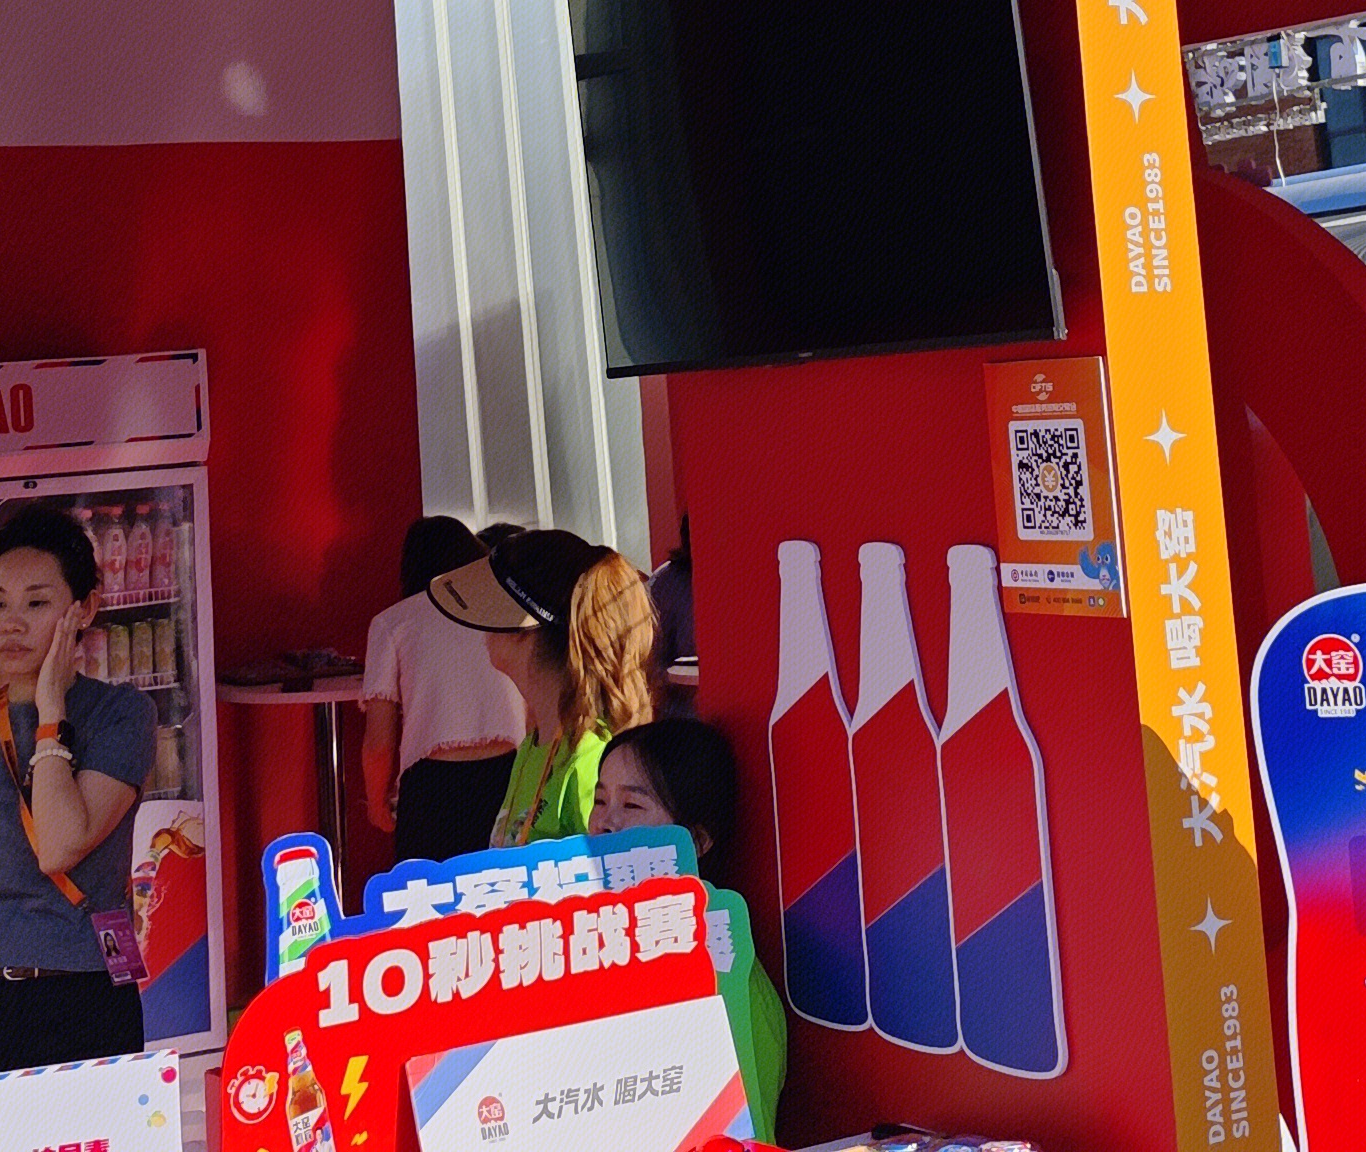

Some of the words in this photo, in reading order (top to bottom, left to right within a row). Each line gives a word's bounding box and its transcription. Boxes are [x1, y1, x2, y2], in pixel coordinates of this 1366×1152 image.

[1123, 205, 1149, 294] DAYAO
[1142, 151, 1173, 293] SINCE1983
[1154, 506, 1206, 670] 喝大窑
[1306, 685, 1364, 707] DAYAO
[1308, 649, 1355, 675] 大窑
[1171, 681, 1225, 848] 大汽水
[291, 921, 320, 937] DAYAO
[317, 892, 699, 1030] 10秒挑战赛
[532, 1082, 605, 1125] 大汽水
[613, 1064, 684, 1106] 喝大窑
[1200, 1047, 1227, 1146] DAYAO
[1218, 983, 1251, 1139] SINCE1983
[480, 1121, 510, 1141] DAYAO
